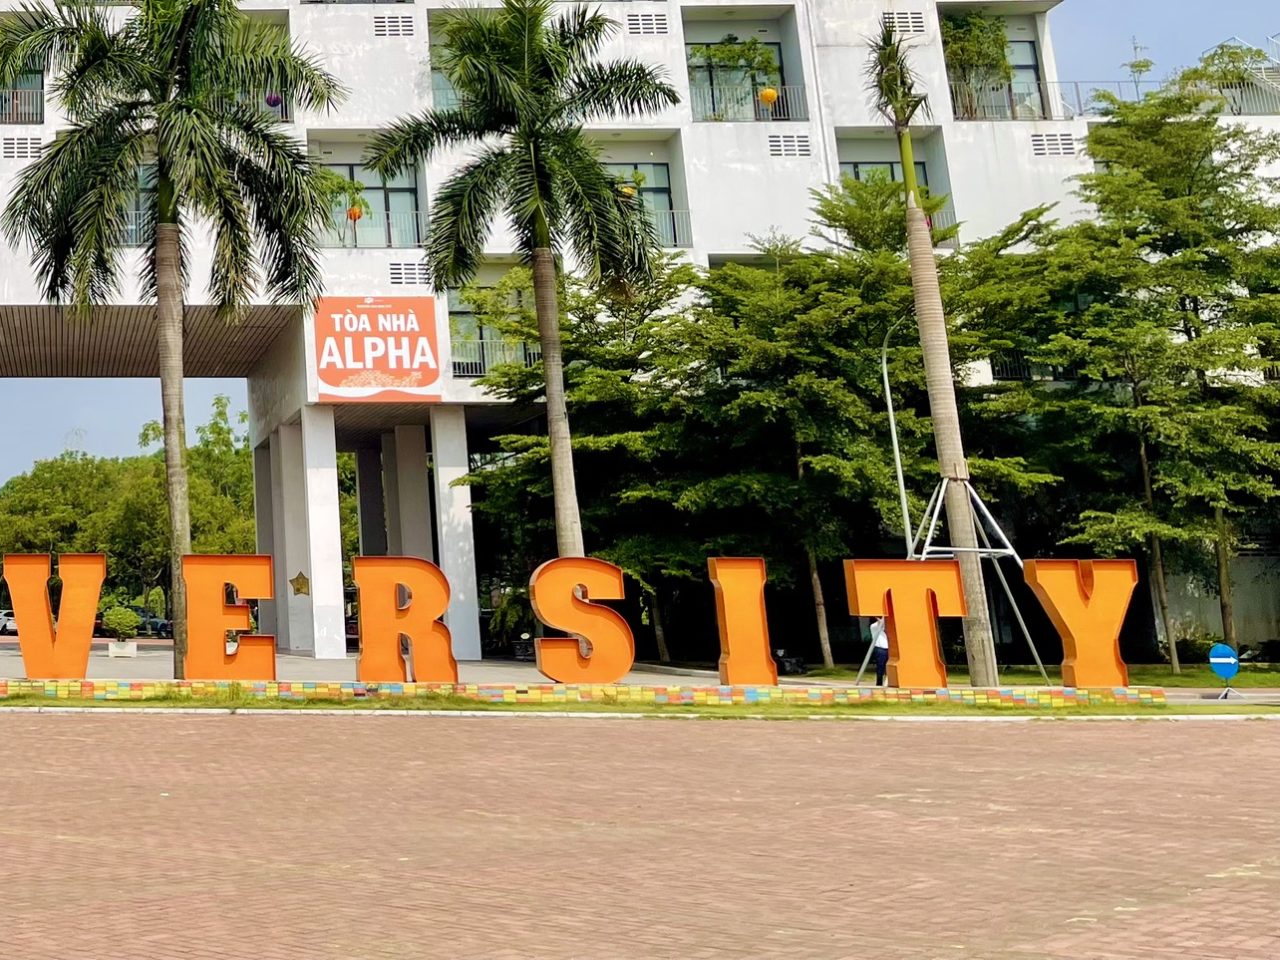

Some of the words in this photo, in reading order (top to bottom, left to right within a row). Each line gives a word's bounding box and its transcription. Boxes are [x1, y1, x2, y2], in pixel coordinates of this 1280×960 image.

[331, 309, 371, 332] TÒA
[378, 309, 419, 332] NHÀ
[319, 336, 438, 369] ALPHA
